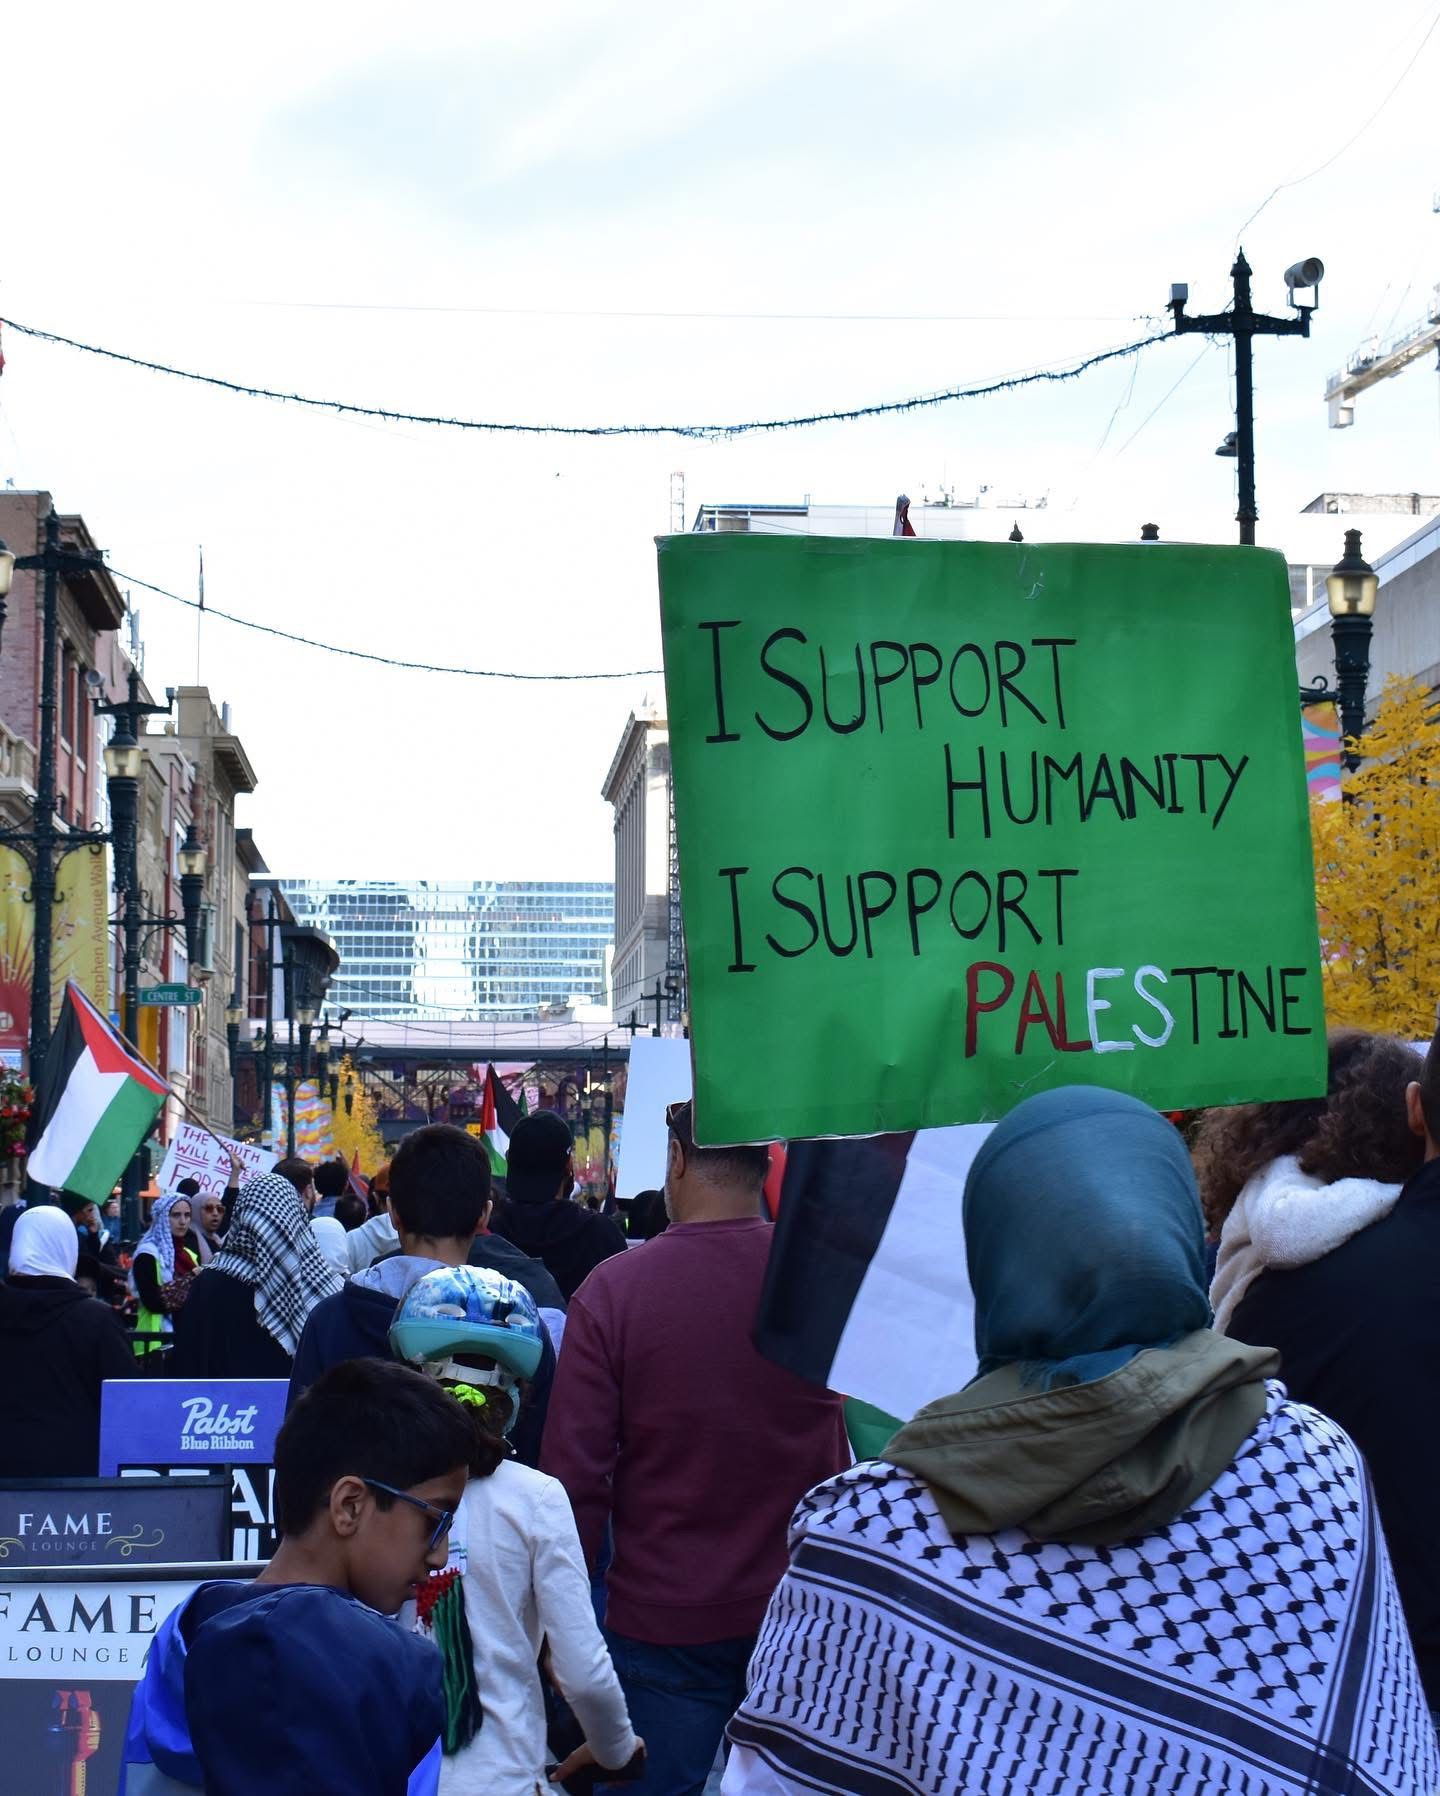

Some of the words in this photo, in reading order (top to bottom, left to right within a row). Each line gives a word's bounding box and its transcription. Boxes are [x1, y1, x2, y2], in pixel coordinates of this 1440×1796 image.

[698, 621, 741, 743] I
[755, 627, 1078, 742] SUPPORT
[944, 743, 1249, 839] HUMANITY
[91, 889, 104, 944] Avenue
[718, 867, 757, 973] I
[765, 866, 1080, 959] SUPPORT
[147, 991, 178, 1001] CENTRE
[185, 991, 194, 1001] ST
[964, 961, 1313, 1059] PALESTINE
[183, 1126, 210, 1146] THE
[176, 1140, 209, 1161] WILL
[181, 1397, 258, 1435] Pabst
[181, 1436, 209, 1450] Blue
[210, 1436, 254, 1450] Ribbon
[18, 1513, 113, 1536] FAME
[32, 1541, 97, 1551] LOUNGE
[8, 1646, 129, 1663] LOUNGE
